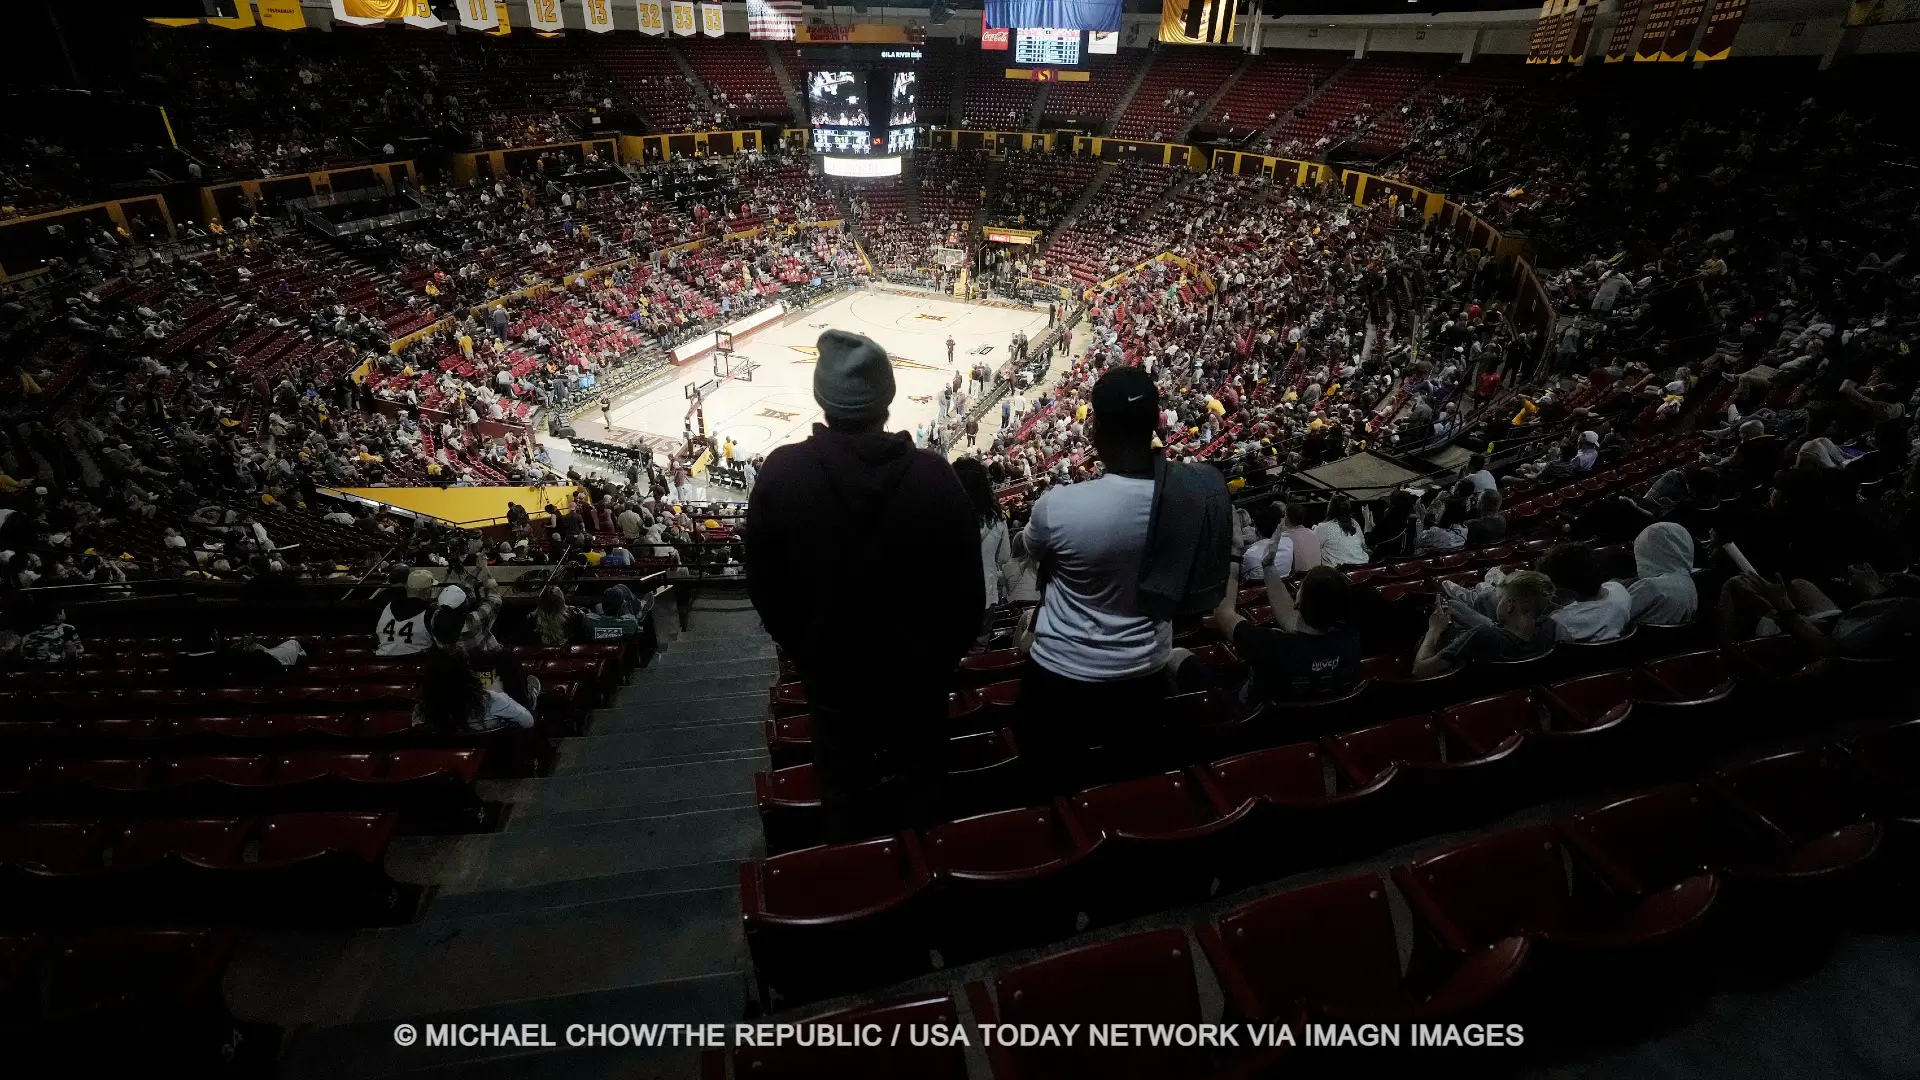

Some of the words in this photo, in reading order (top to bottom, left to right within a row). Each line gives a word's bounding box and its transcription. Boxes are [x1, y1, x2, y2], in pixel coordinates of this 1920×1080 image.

[533, 0, 558, 23] 12
[587, 0, 608, 25] 13
[639, 2, 662, 29] 32
[673, 5, 693, 30] 33
[705, 7, 721, 31] 53
[382, 620, 414, 644] 44
